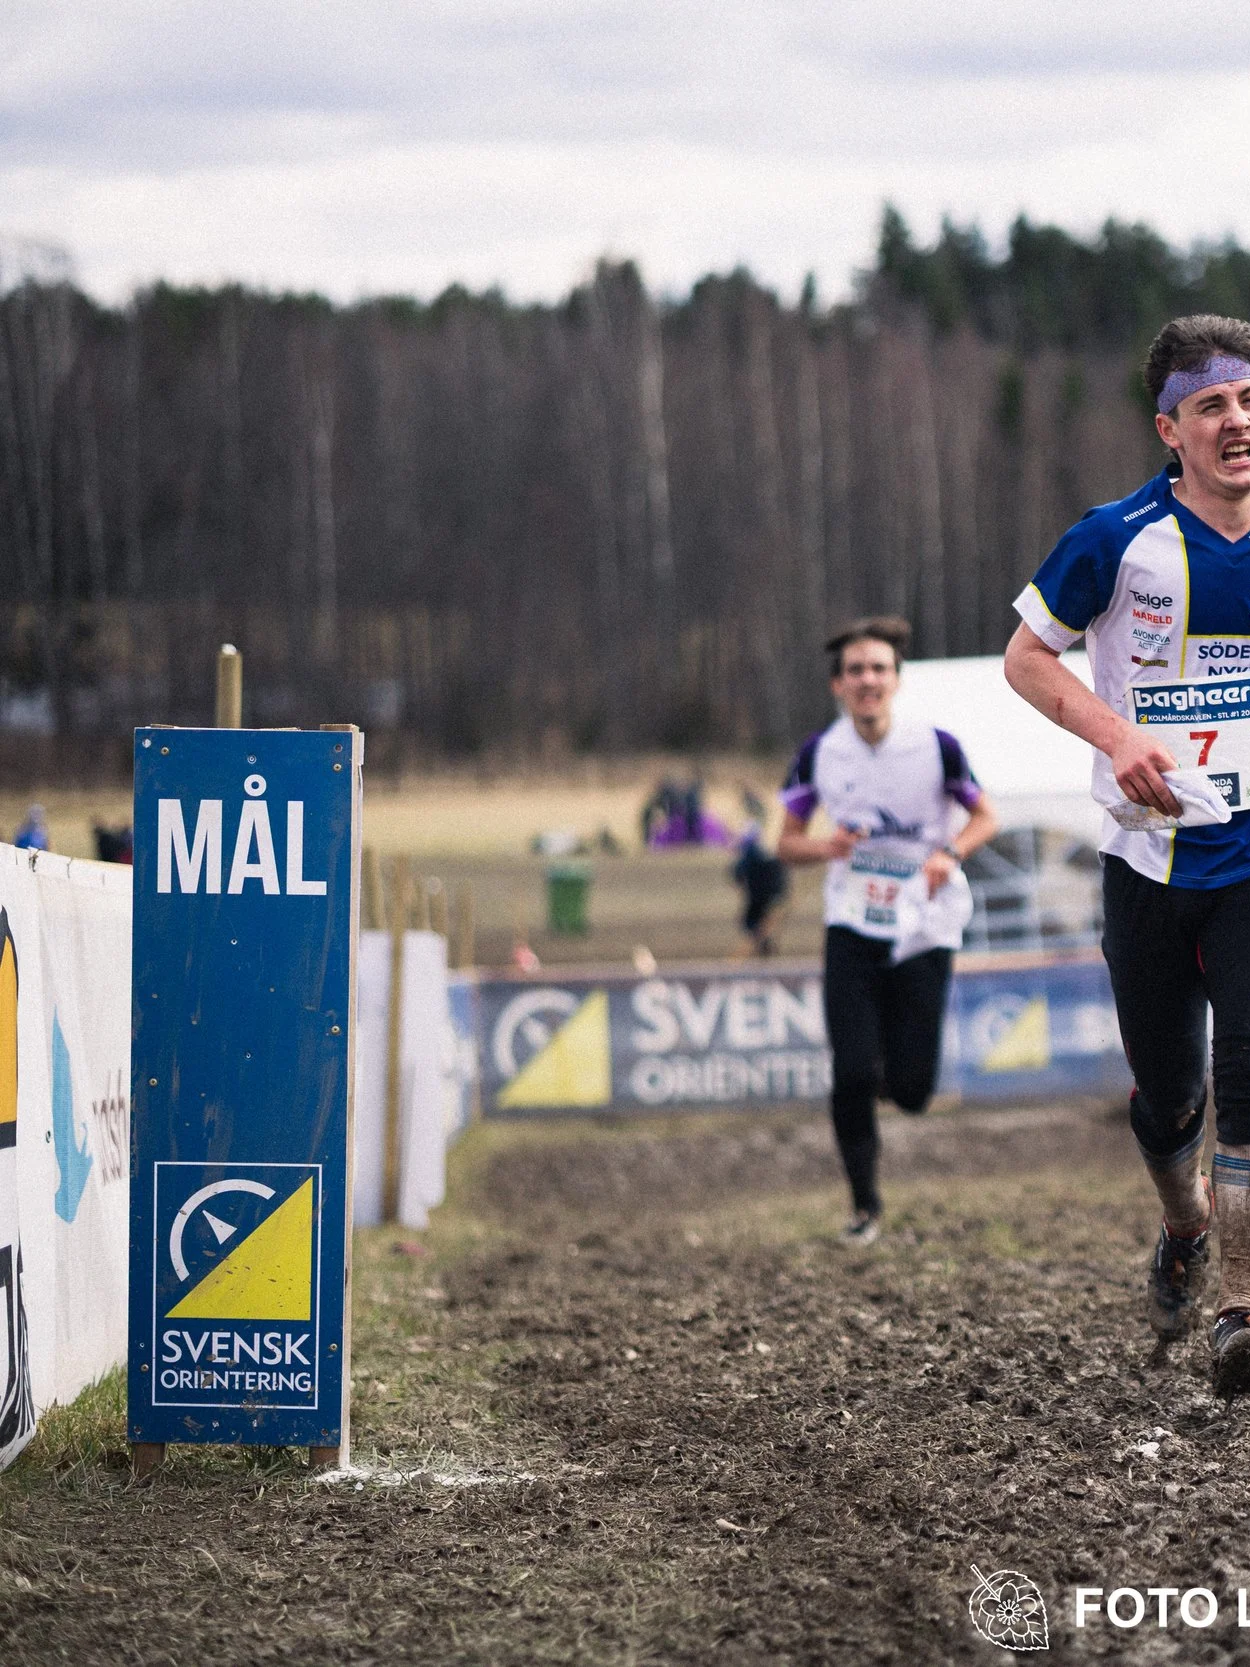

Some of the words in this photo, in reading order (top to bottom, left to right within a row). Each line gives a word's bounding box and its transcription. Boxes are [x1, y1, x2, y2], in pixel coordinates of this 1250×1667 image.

[1129, 590, 1173, 609] Telge
[1132, 609, 1173, 625] MARELD
[1132, 628, 1171, 643] AVONOVA
[1217, 711, 1230, 719] STL
[1189, 730, 1219, 767] 7
[157, 774, 328, 896] MÅL
[161, 1330, 312, 1365] SVENSK
[160, 1369, 312, 1392] ORIENTERING
